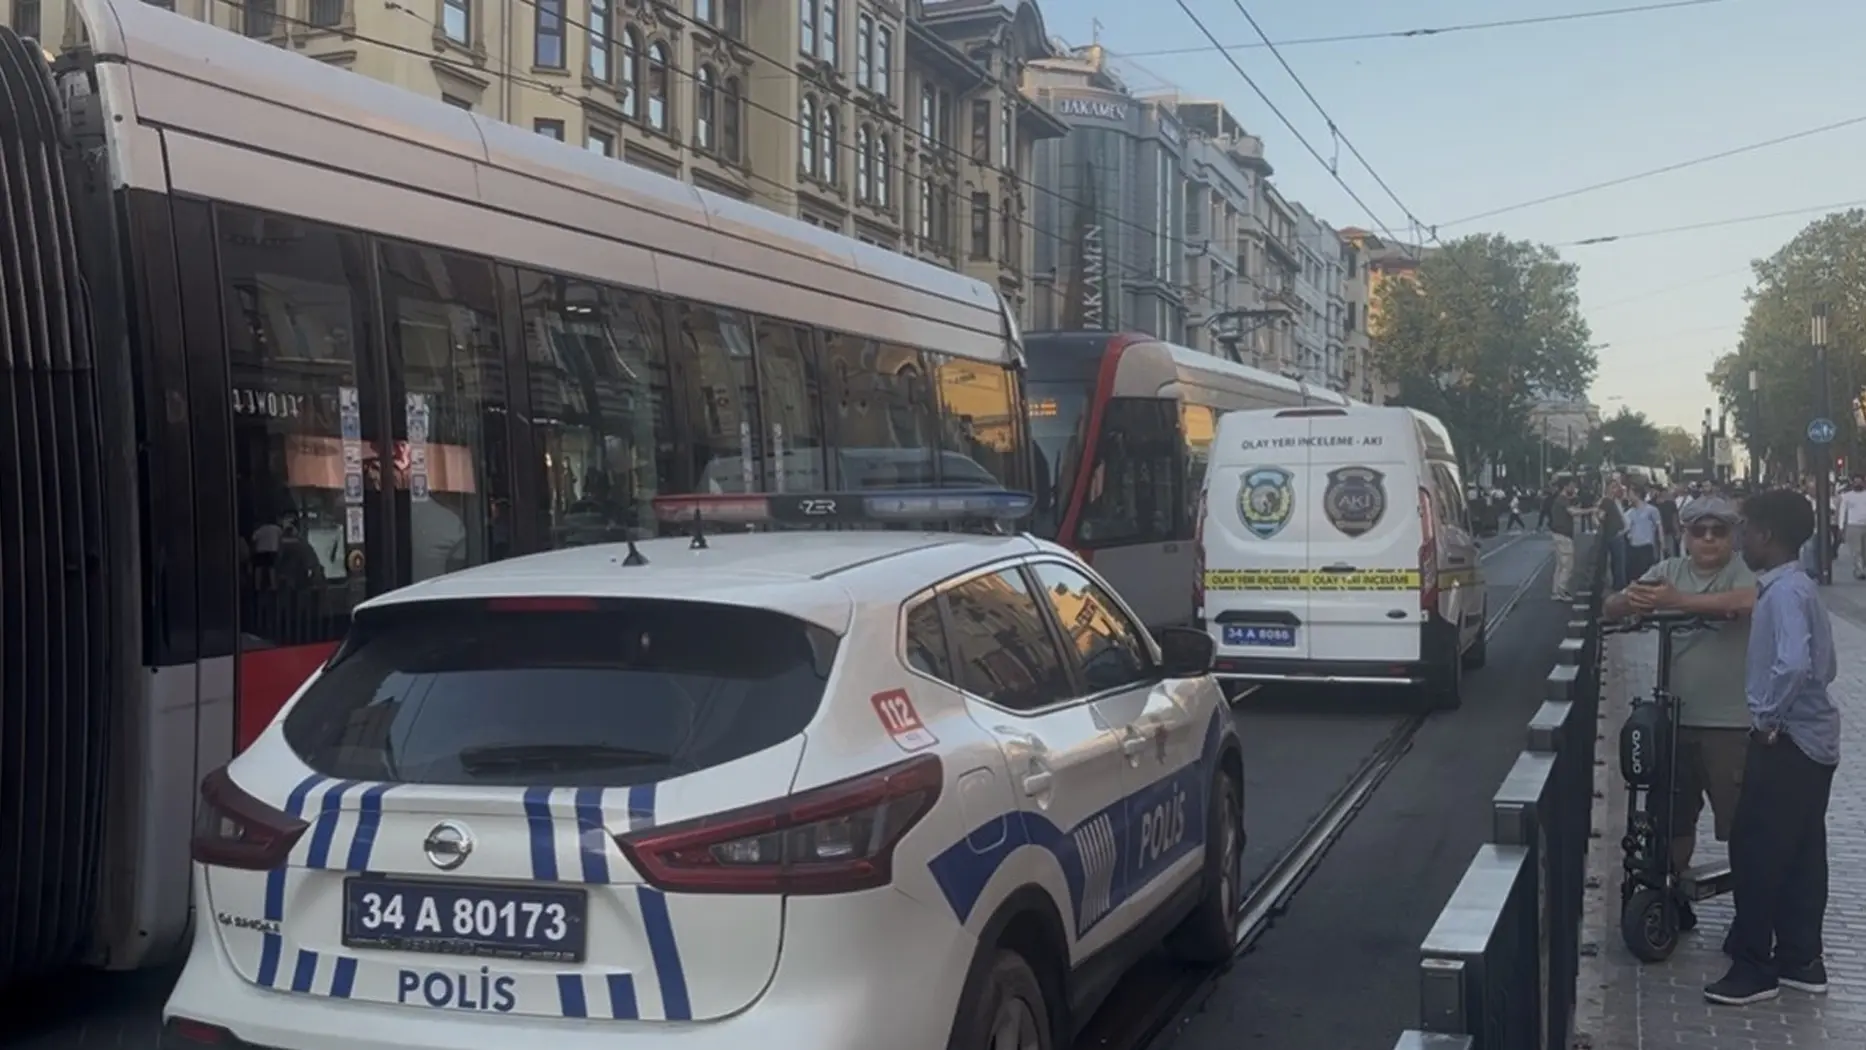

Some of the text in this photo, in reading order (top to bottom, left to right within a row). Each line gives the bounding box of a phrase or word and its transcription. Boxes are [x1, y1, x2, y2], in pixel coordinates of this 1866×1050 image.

[1241, 439, 1269, 450] OLAY
[1228, 627, 1243, 639] 34
[1246, 628, 1256, 639] A
[880, 696, 917, 729] 112
[1139, 781, 1186, 870] POLİS
[362, 892, 567, 941] 34 A 80173
[398, 966, 516, 1012] POLİS
